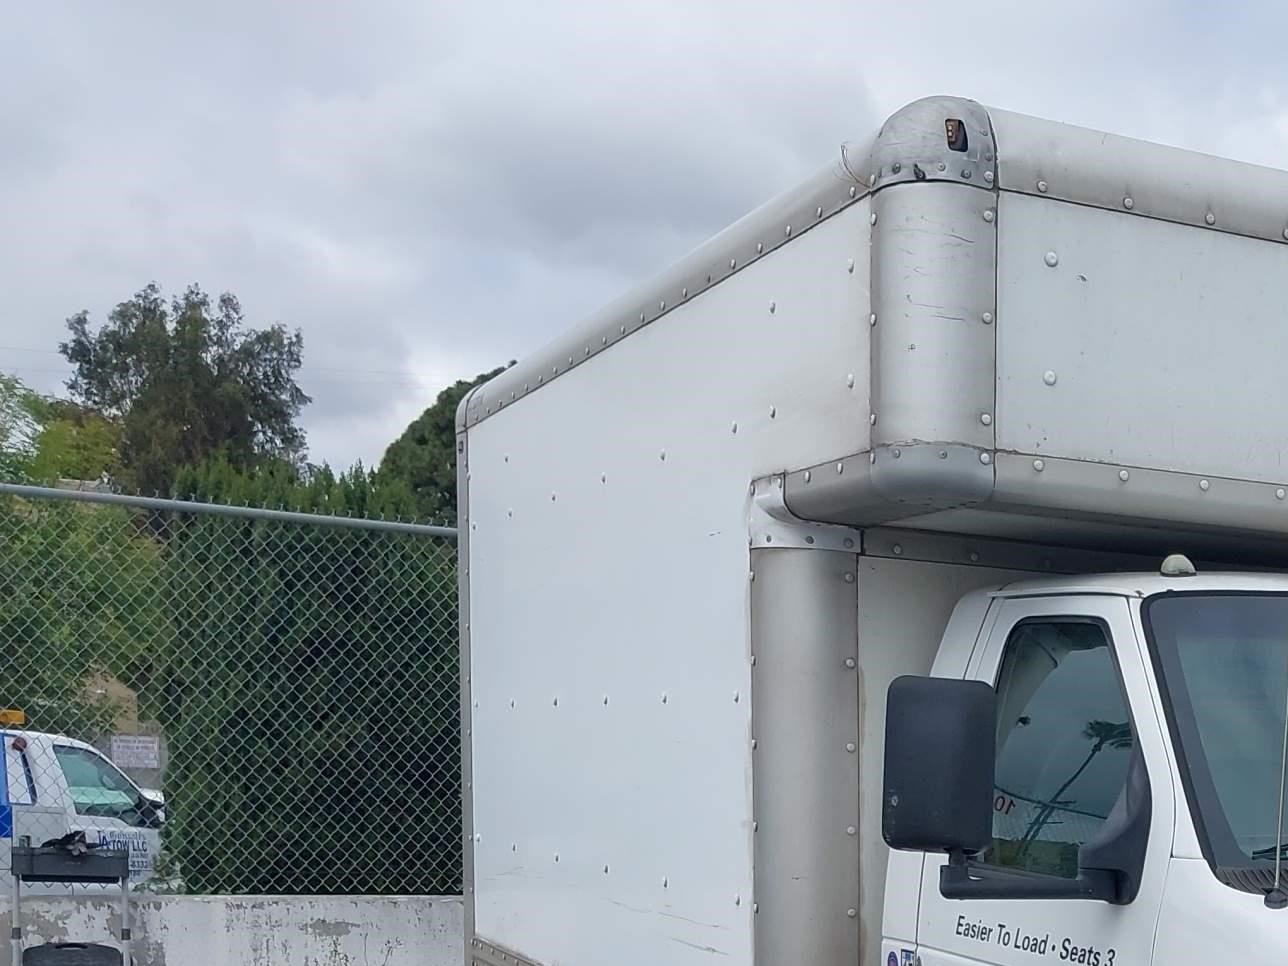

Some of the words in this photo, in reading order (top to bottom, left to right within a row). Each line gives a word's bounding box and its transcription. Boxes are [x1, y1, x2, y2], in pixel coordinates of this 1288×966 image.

[132, 841, 148, 852] LLC
[955, 915, 994, 943] Easier
[997, 923, 1011, 947] To
[1014, 927, 1049, 955] Load
